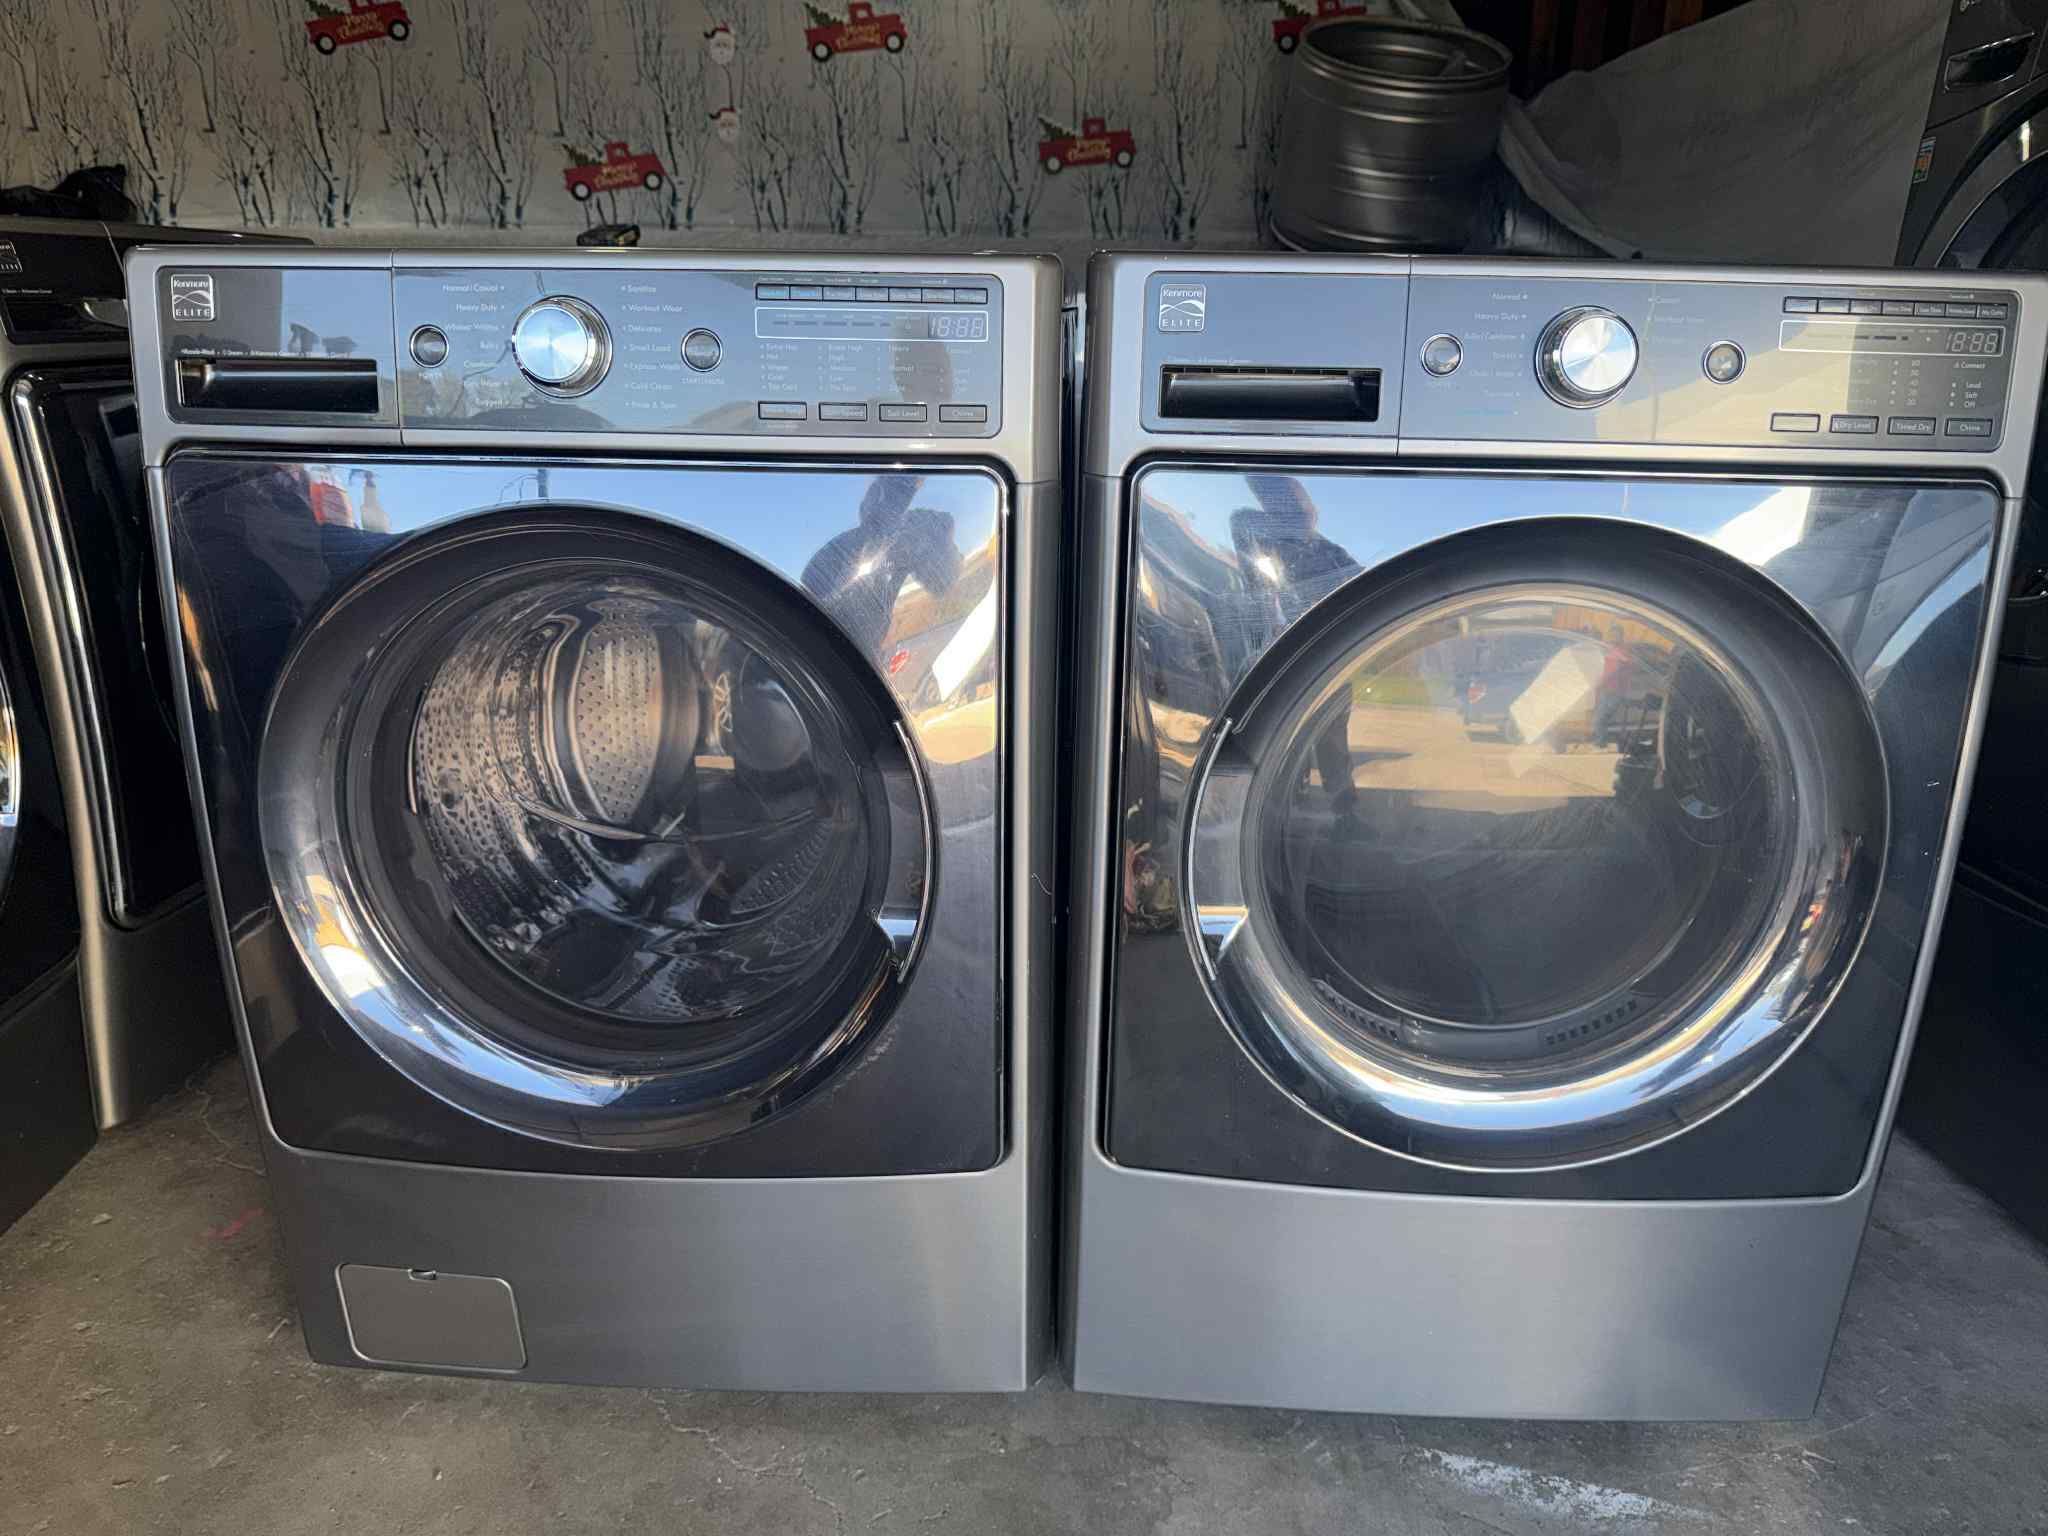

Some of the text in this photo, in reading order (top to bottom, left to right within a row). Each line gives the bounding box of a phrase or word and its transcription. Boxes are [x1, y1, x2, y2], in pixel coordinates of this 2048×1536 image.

[173, 279, 210, 289] Kenmore
[1162, 288, 1202, 298] Kenmore
[175, 308, 212, 318] ELITE
[1161, 319, 1202, 329] ELITE
